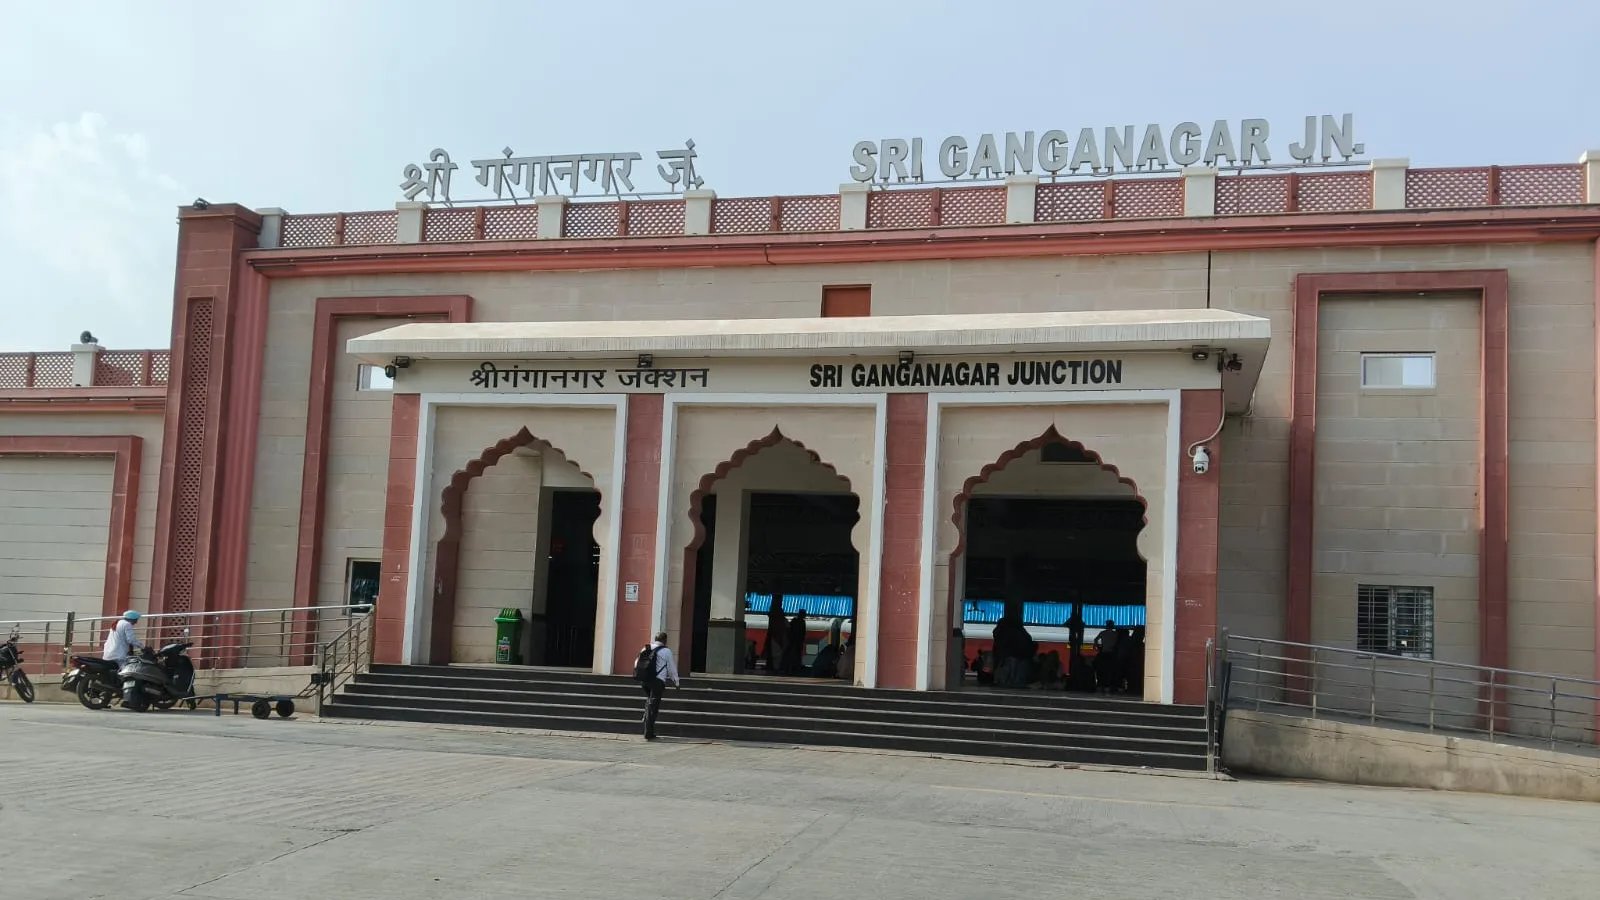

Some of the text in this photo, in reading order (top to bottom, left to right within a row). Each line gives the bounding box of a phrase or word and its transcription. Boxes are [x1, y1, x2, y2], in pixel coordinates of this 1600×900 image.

[850, 113, 1365, 182] SRI GANGANAGAR JN.
[400, 148, 458, 201] श्री
[471, 146, 642, 198] गंगानगर
[469, 361, 607, 388] श्रीगंगानगर
[809, 360, 1122, 388] SRI GANGANAGAR JUNCTION
